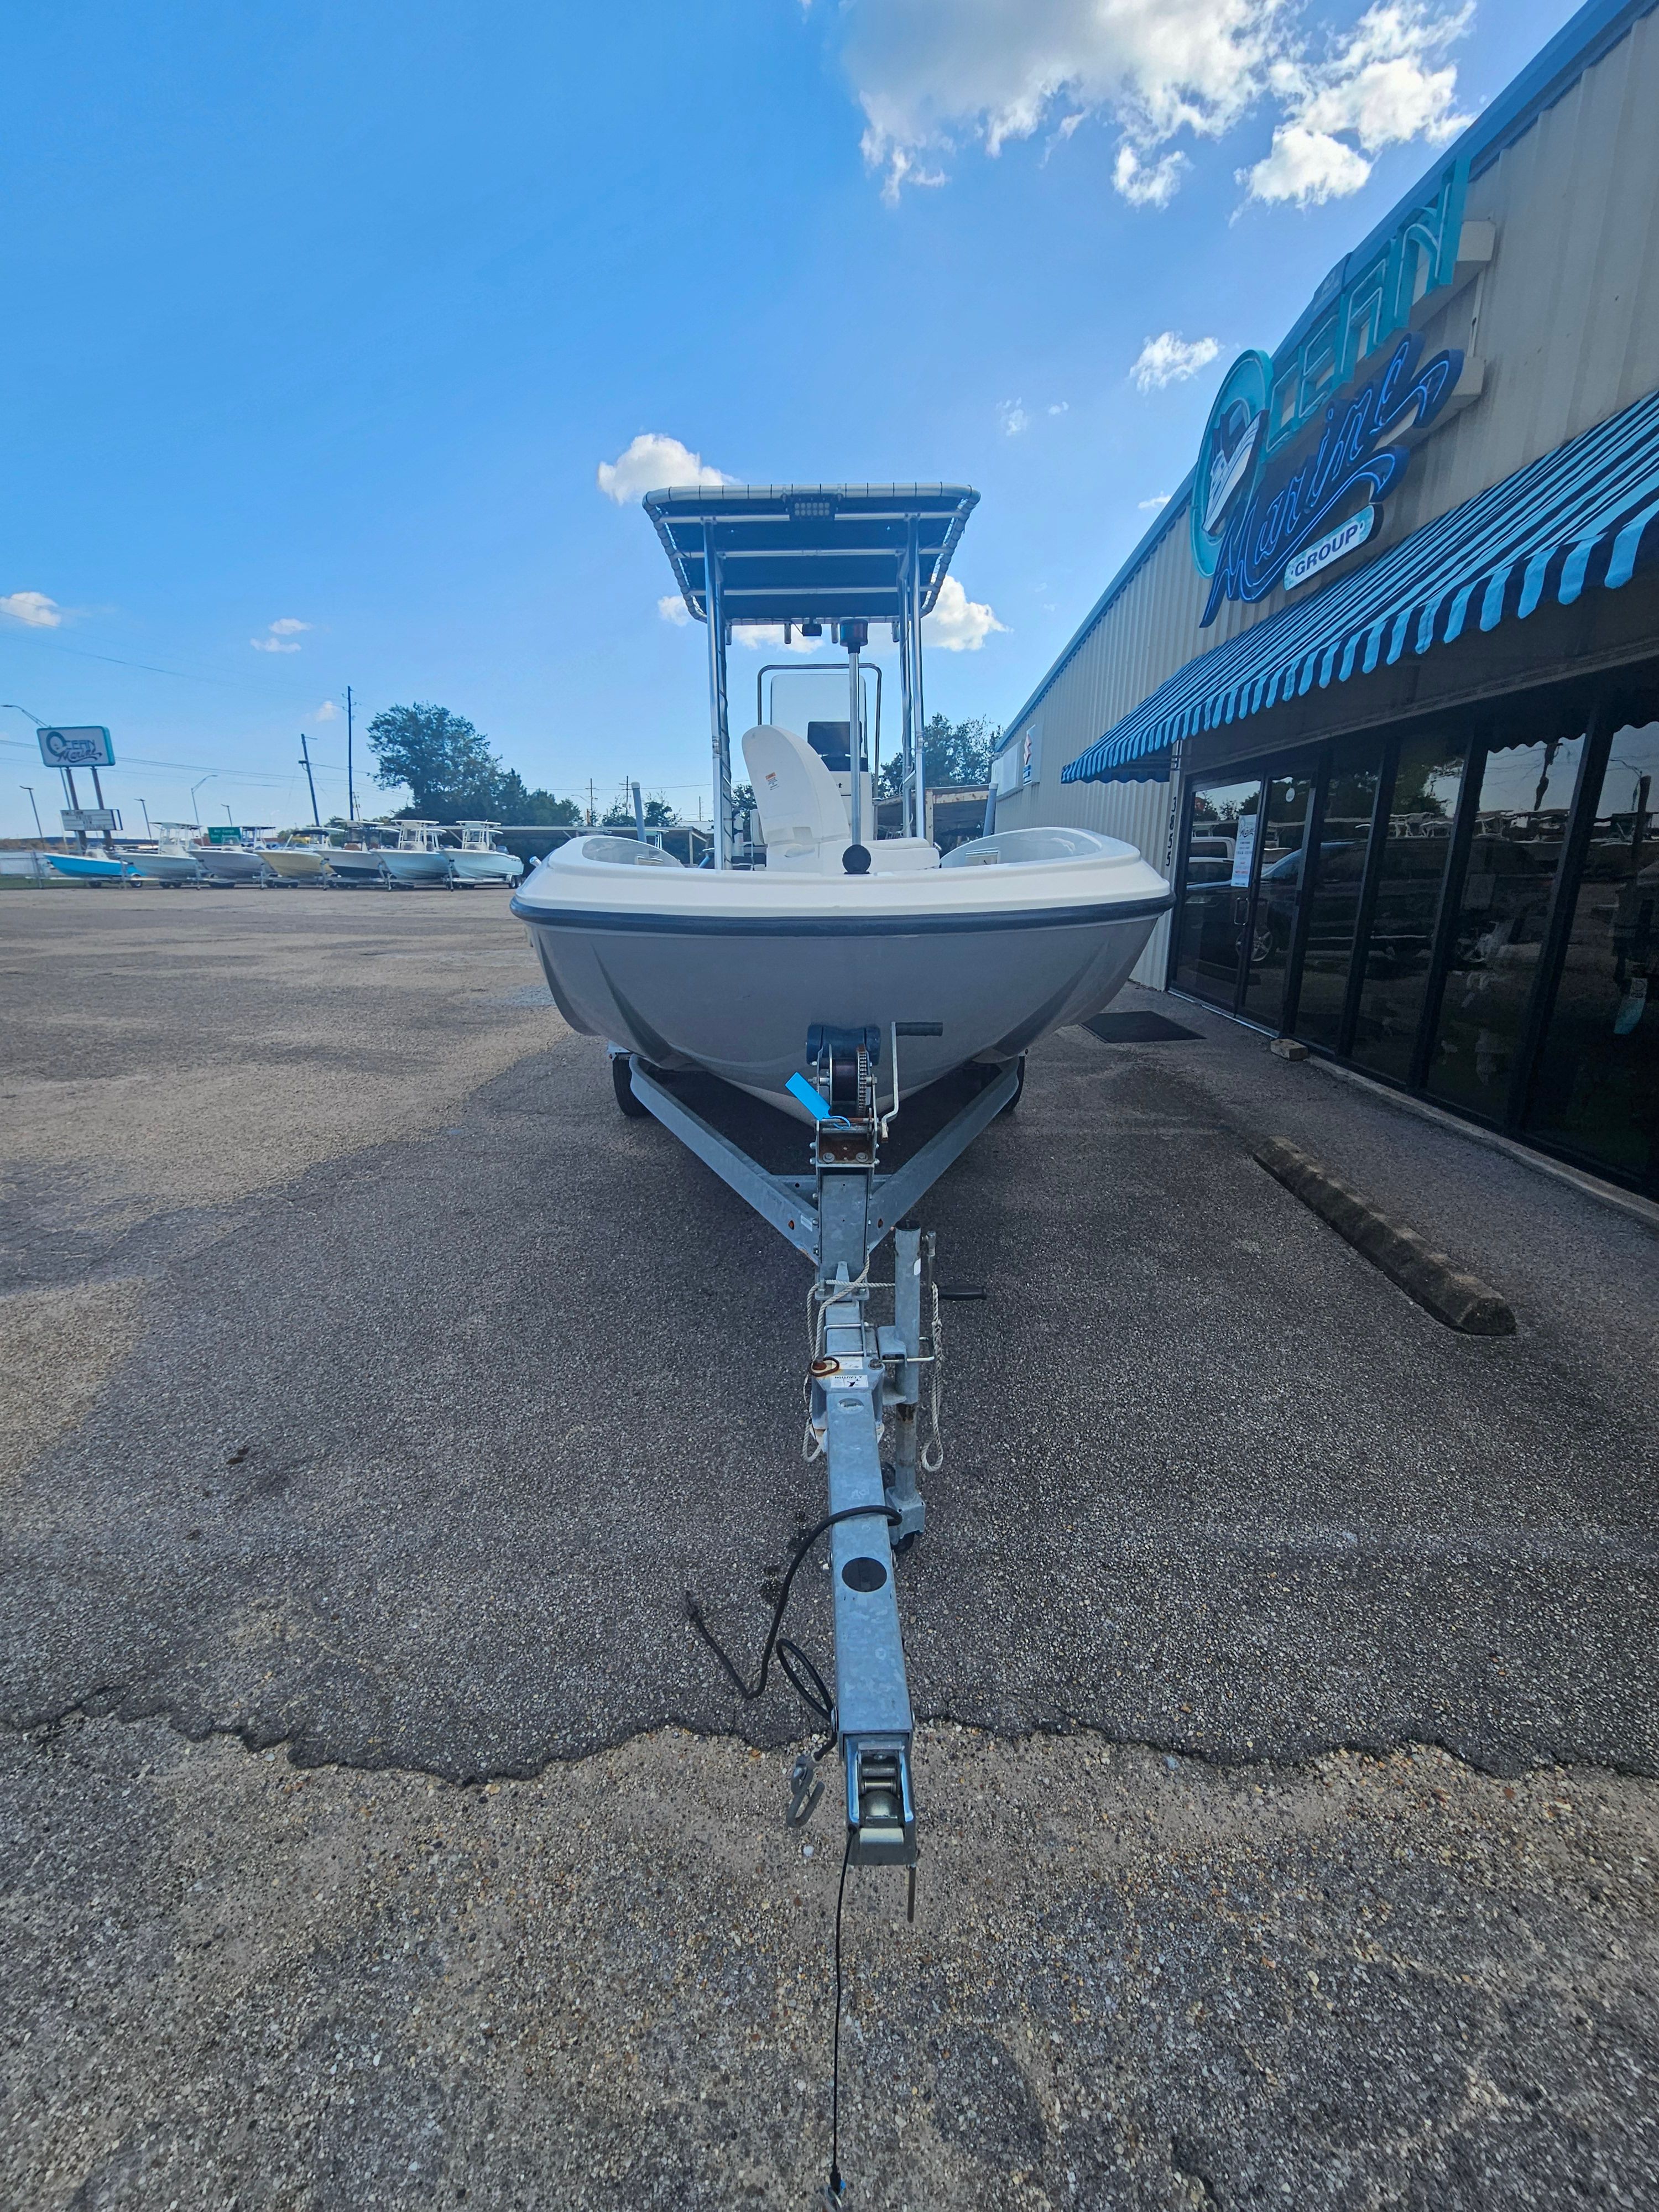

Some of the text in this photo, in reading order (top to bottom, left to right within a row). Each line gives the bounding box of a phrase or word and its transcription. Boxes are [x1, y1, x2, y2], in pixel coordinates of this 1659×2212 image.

[1191, 156, 1472, 578] OCEAN
[1199, 333, 1464, 628] Marine
[1295, 524, 1358, 577] GROUP
[46, 731, 96, 757] OCEAN
[57, 748, 102, 763] Marine
[1166, 796, 1177, 867] 3855
